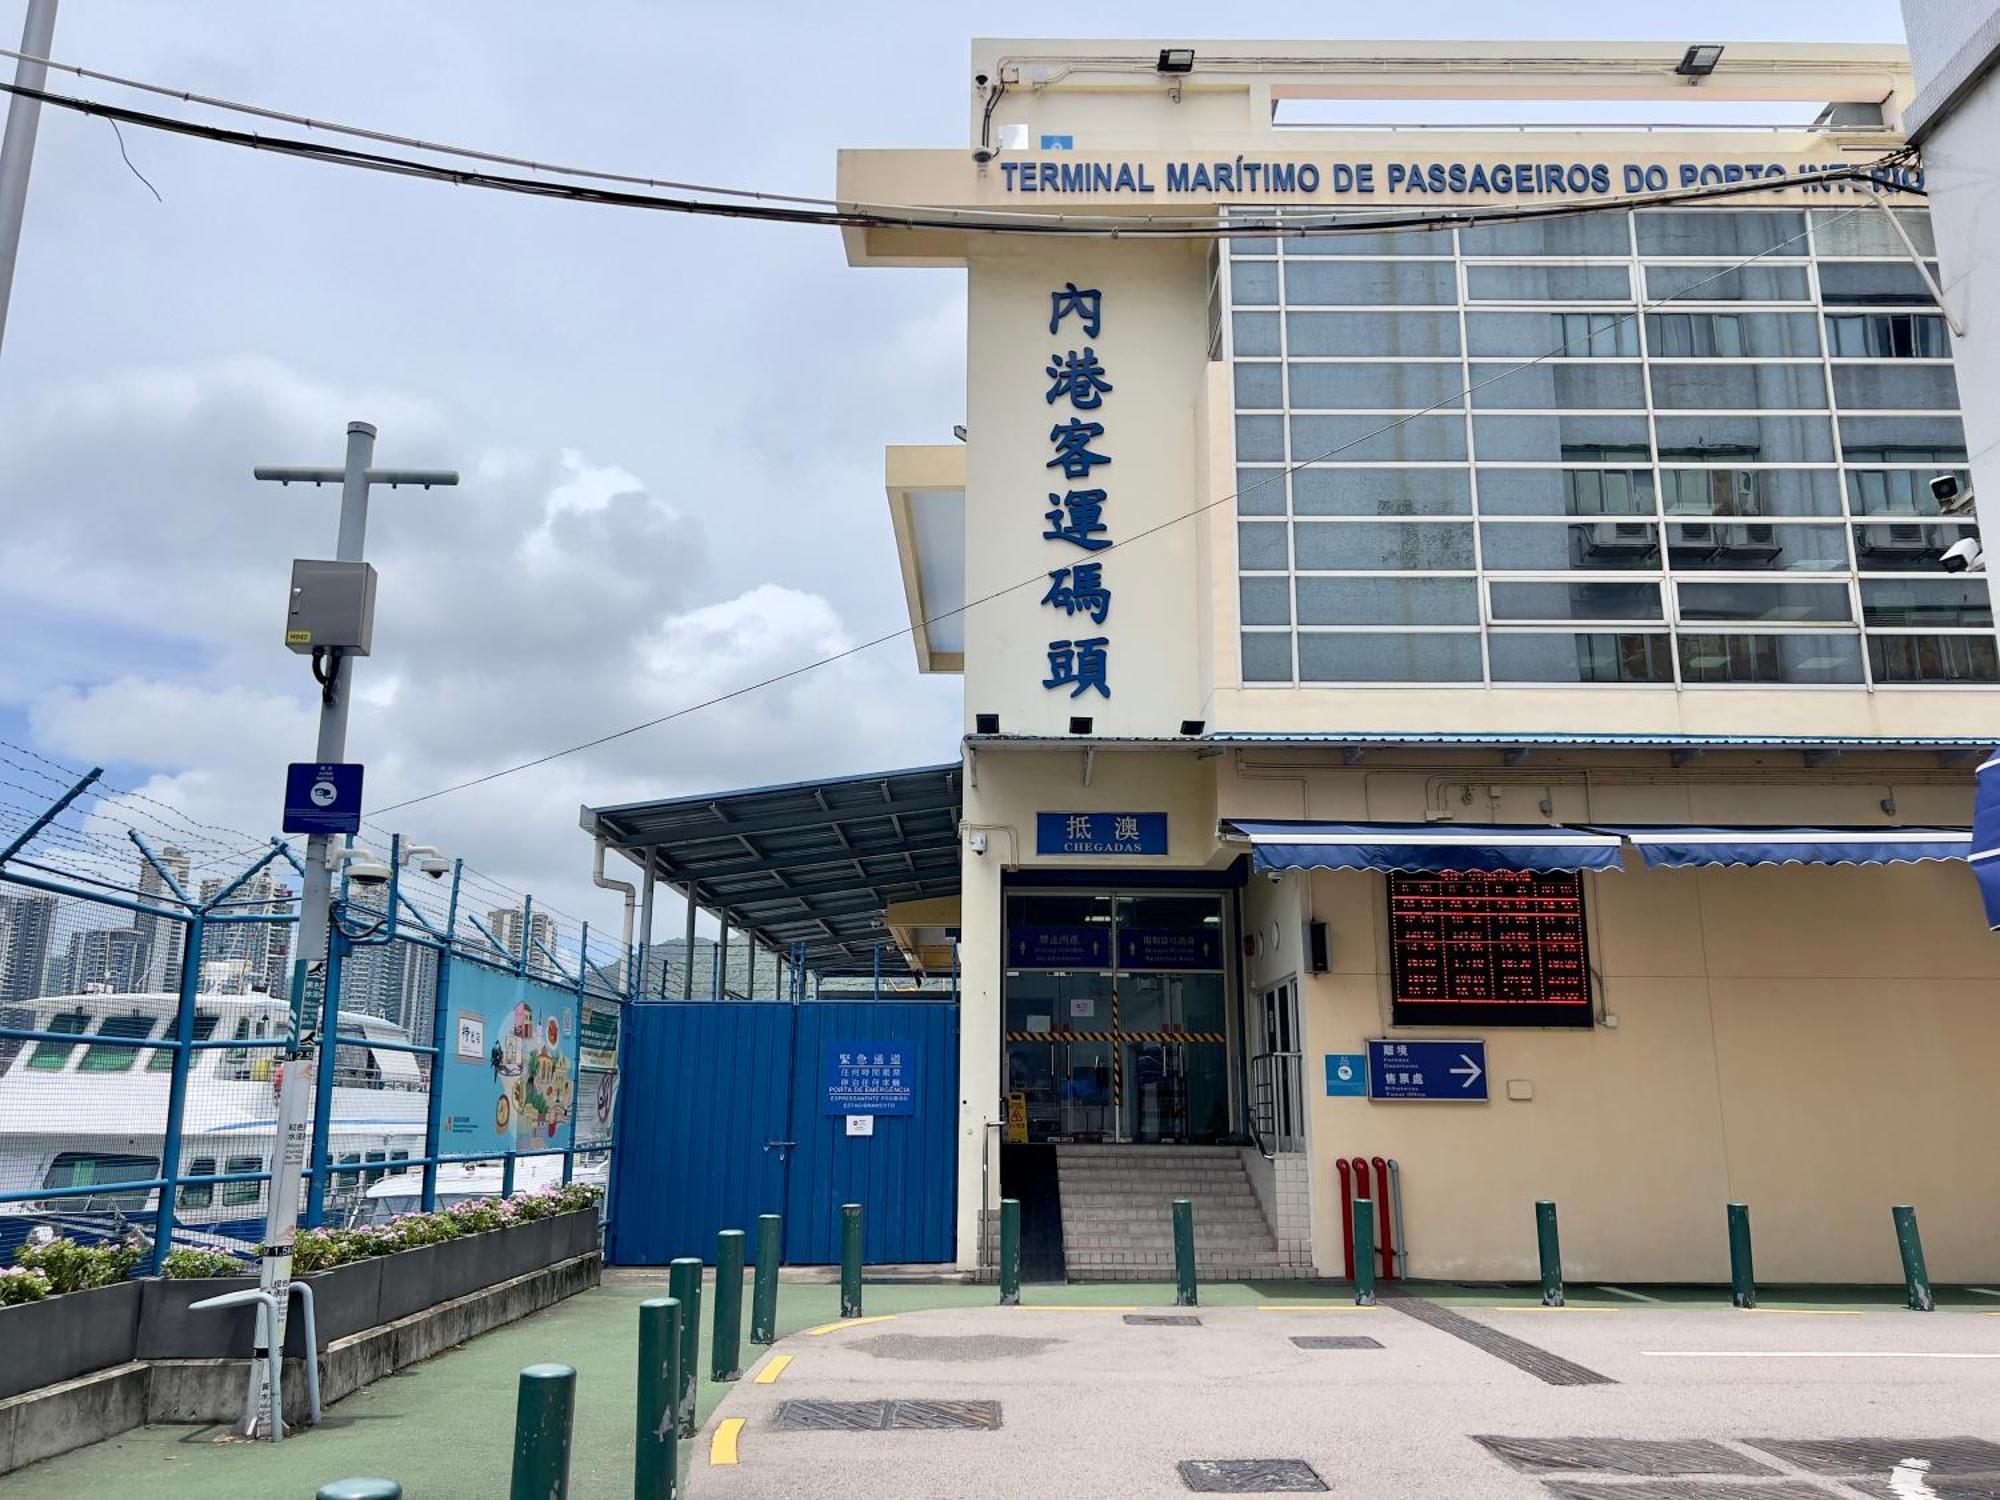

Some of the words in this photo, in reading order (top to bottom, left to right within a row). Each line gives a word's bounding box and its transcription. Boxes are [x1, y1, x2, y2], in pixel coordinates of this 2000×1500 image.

[1000, 161, 1154, 194] TERMINAL
[1167, 155, 1320, 194] MARÍTIMO
[1333, 162, 1375, 194] DE
[1387, 162, 1611, 194] PASSAGEIROS
[1623, 163, 1668, 193] DO
[1041, 281, 1114, 700] 內港客運碼頭
[1066, 815, 1141, 840] 抵澳
[1064, 841, 1142, 853] CHEGADAS
